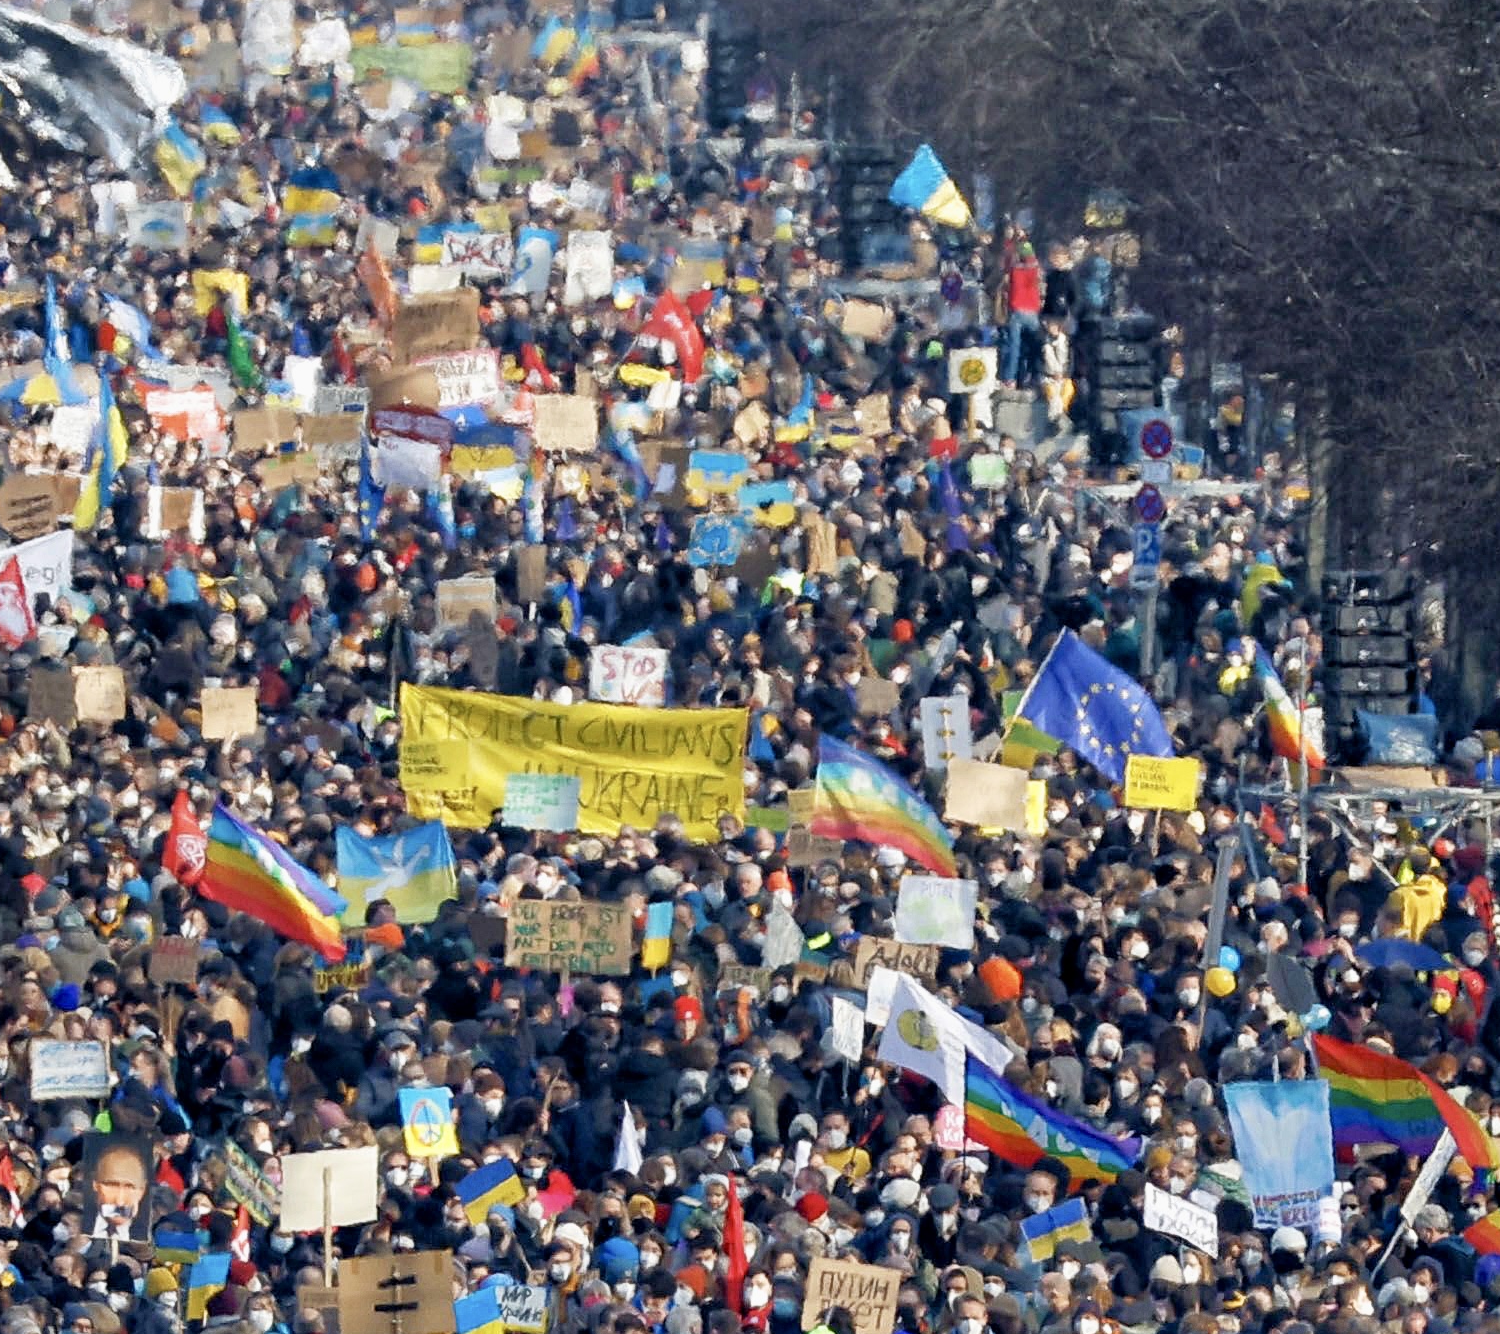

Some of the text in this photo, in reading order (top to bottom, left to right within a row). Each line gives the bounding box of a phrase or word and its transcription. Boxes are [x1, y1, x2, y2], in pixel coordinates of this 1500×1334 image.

[1138, 529, 1152, 548] P
[601, 650, 657, 680] STOP
[419, 699, 742, 766] PROTECT CIVILIANS
[820, 1269, 889, 1301] ПУТИН
